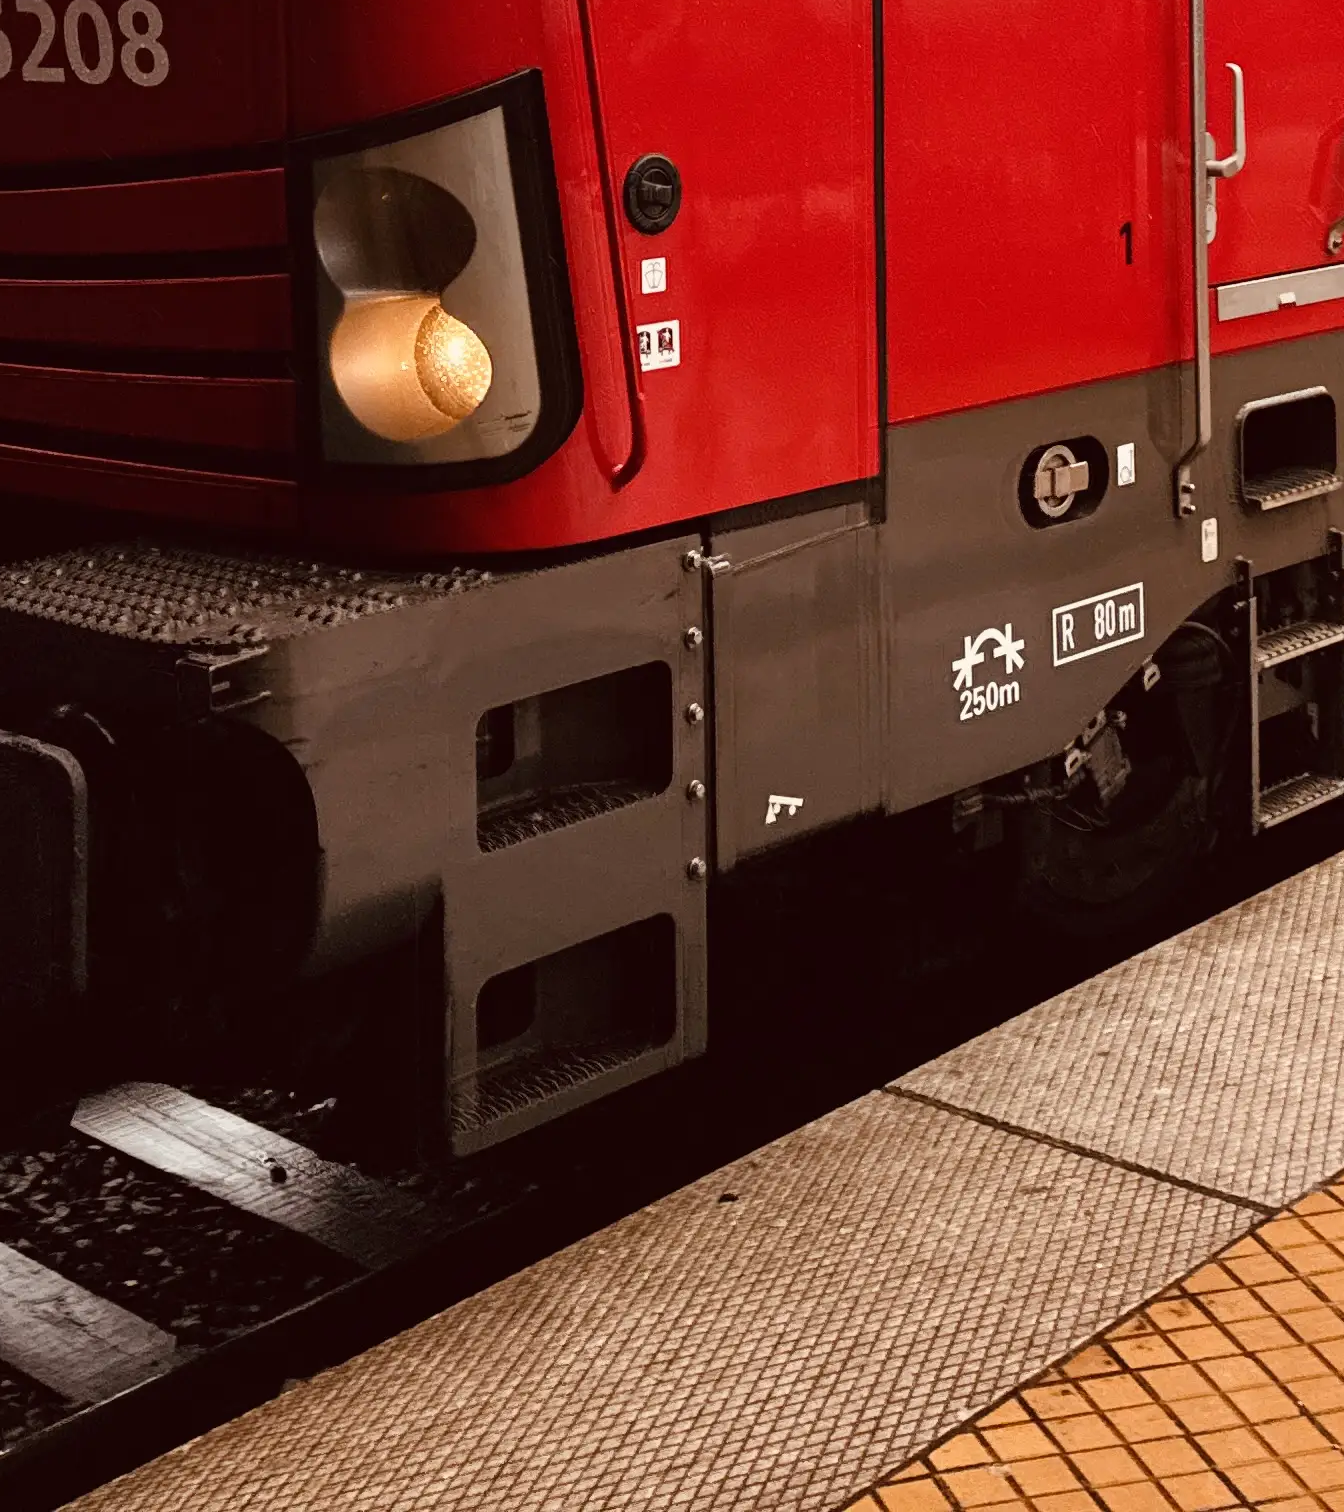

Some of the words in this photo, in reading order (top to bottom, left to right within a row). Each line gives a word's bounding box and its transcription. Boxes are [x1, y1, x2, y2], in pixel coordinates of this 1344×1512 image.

[1119, 221, 1133, 265] 1
[1062, 613, 1075, 651] R
[960, 681, 1020, 721] 250m
